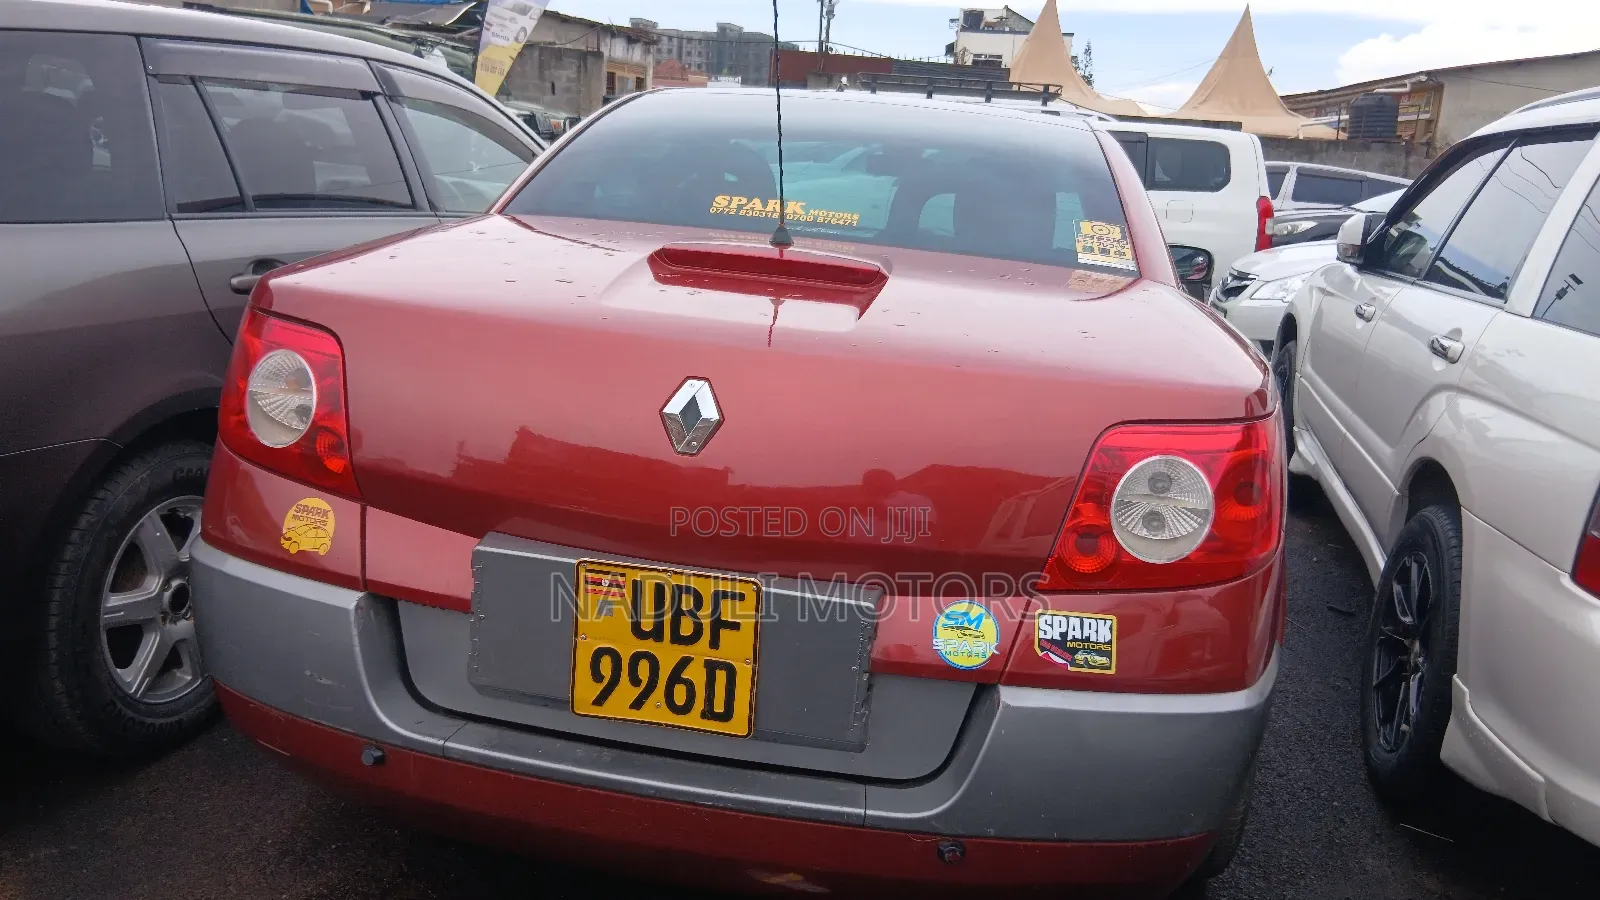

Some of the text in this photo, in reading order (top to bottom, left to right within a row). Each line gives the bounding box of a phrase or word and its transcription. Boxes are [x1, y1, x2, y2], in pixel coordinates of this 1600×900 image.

[709, 206, 737, 216] 0772
[786, 213, 814, 223] 0700
[817, 216, 859, 227] 876471
[712, 195, 860, 221] SPARK MOTORS
[292, 513, 328, 527] MOTORS
[294, 503, 331, 519] SPARK
[630, 578, 746, 651] UBF
[941, 610, 986, 631] SM
[1038, 614, 1112, 643] SPARK
[932, 637, 1000, 655] SPARK
[944, 650, 987, 659] MOTORS
[1066, 641, 1112, 651] MOTORS
[589, 645, 738, 723] 996D
